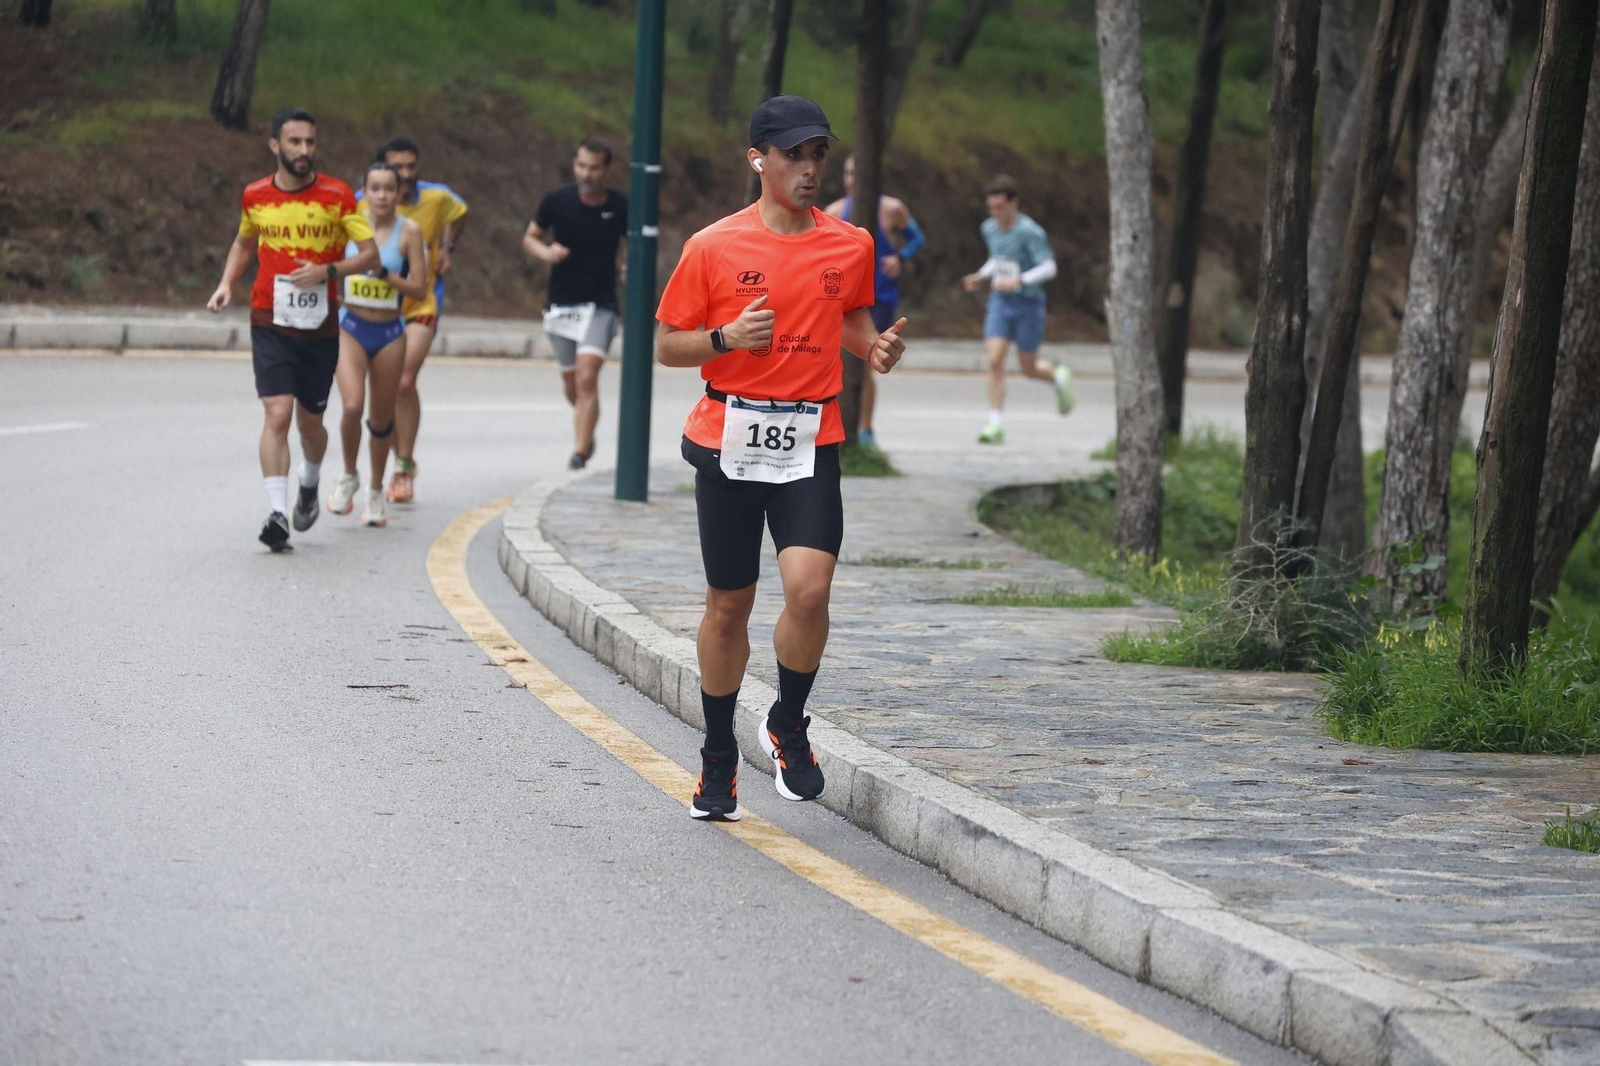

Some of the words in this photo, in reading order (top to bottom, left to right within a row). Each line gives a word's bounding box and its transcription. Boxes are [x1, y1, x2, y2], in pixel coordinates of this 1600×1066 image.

[296, 222, 333, 239] VIVA!
[352, 282, 392, 299] 1017
[287, 292, 319, 308] 169
[779, 334, 810, 343] Ciudad
[777, 345, 790, 353] de
[791, 343, 822, 354] Málaga
[746, 423, 797, 451] 185
